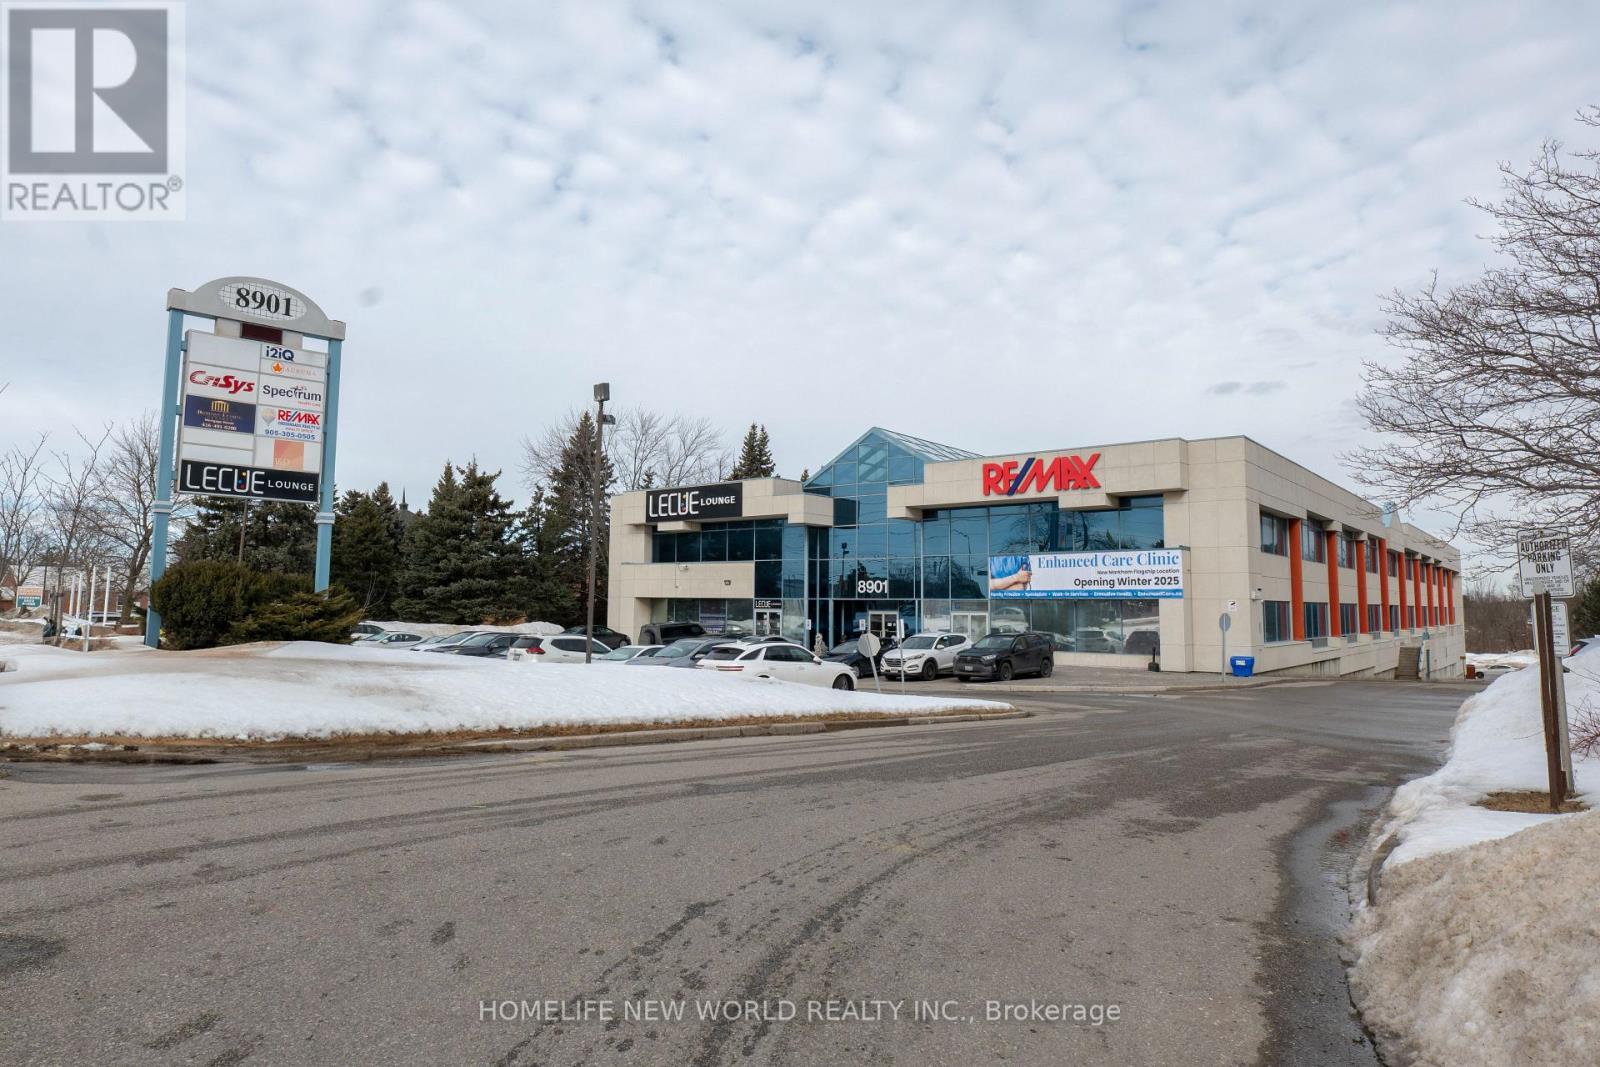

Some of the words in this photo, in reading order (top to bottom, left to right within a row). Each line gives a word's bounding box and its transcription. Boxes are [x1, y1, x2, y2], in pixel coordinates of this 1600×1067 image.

[235, 287, 294, 318] 8901
[265, 345, 295, 362] i2iQ
[262, 384, 322, 402] Spectrum
[277, 409, 321, 426] RE/MAX
[264, 429, 316, 440] 905-305-0505
[186, 463, 266, 495] LECUE
[267, 479, 315, 492] LOUNGE
[982, 453, 1102, 497] RE/MAX
[649, 490, 699, 518] LECUE
[700, 495, 737, 507] LOUNGE
[1520, 539, 1568, 552] AUTHORIZED
[1038, 554, 1098, 569] Enhanced
[1102, 554, 1133, 567] Care
[1137, 551, 1180, 566] Clinic
[1527, 551, 1562, 563] PARKING
[1535, 563, 1554, 574] ONLY
[857, 580, 888, 594] 8901
[1073, 577, 1115, 589] Opening
[1117, 577, 1152, 586] Winter
[1154, 576, 1180, 586] 2025
